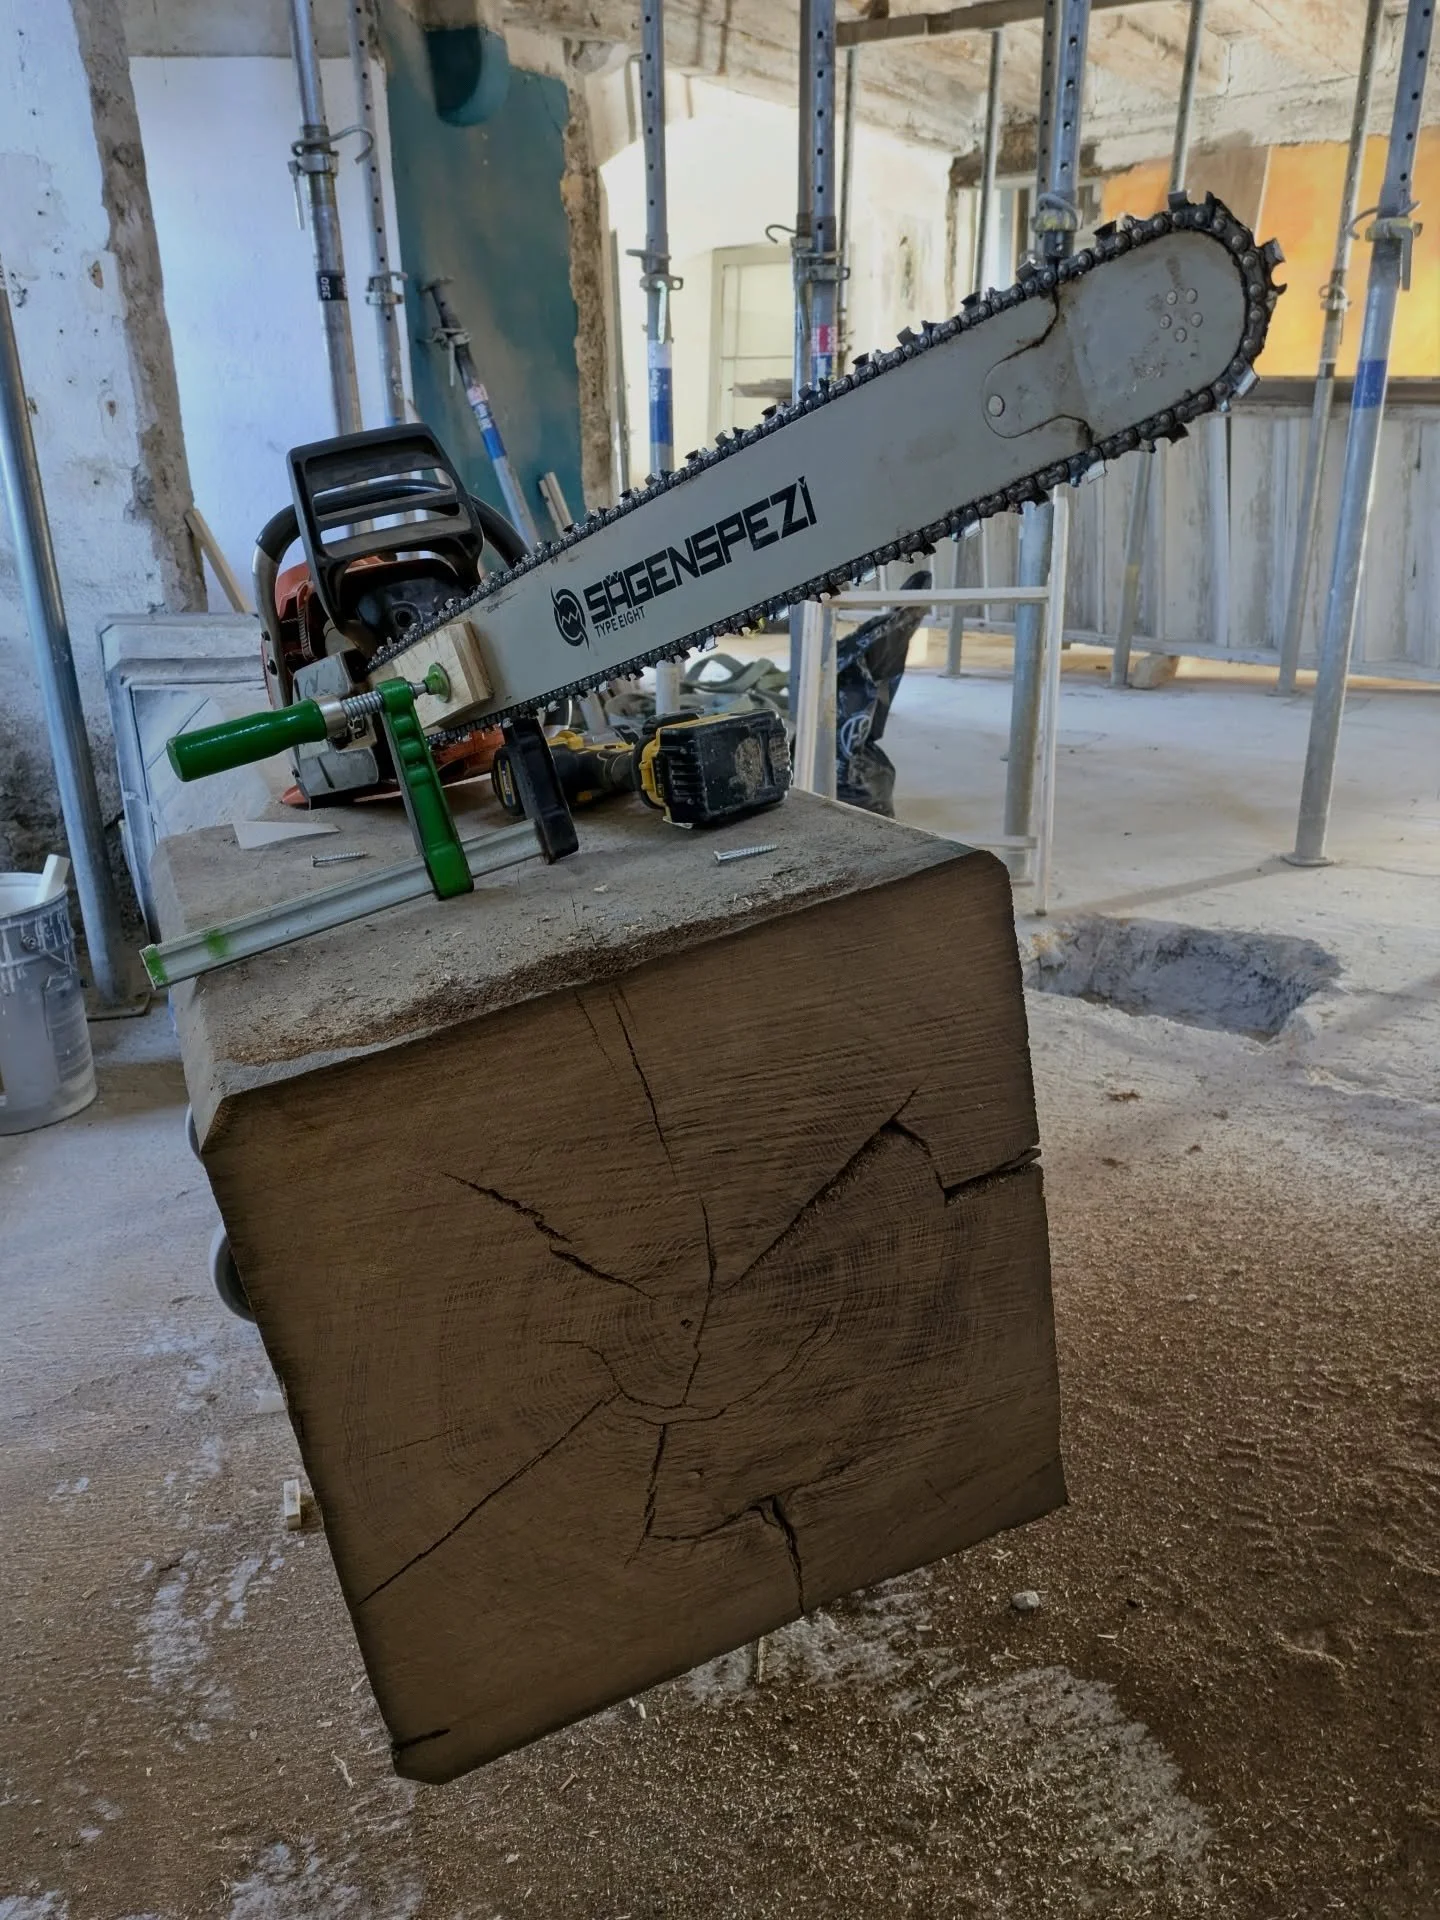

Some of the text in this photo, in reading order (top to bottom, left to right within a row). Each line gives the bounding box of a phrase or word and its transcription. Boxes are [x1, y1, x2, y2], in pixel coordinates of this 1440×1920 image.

[320, 276, 331, 299] 350
[583, 475, 817, 624] SÄGENSPEZI
[594, 606, 645, 638] TYPE EIGHT
